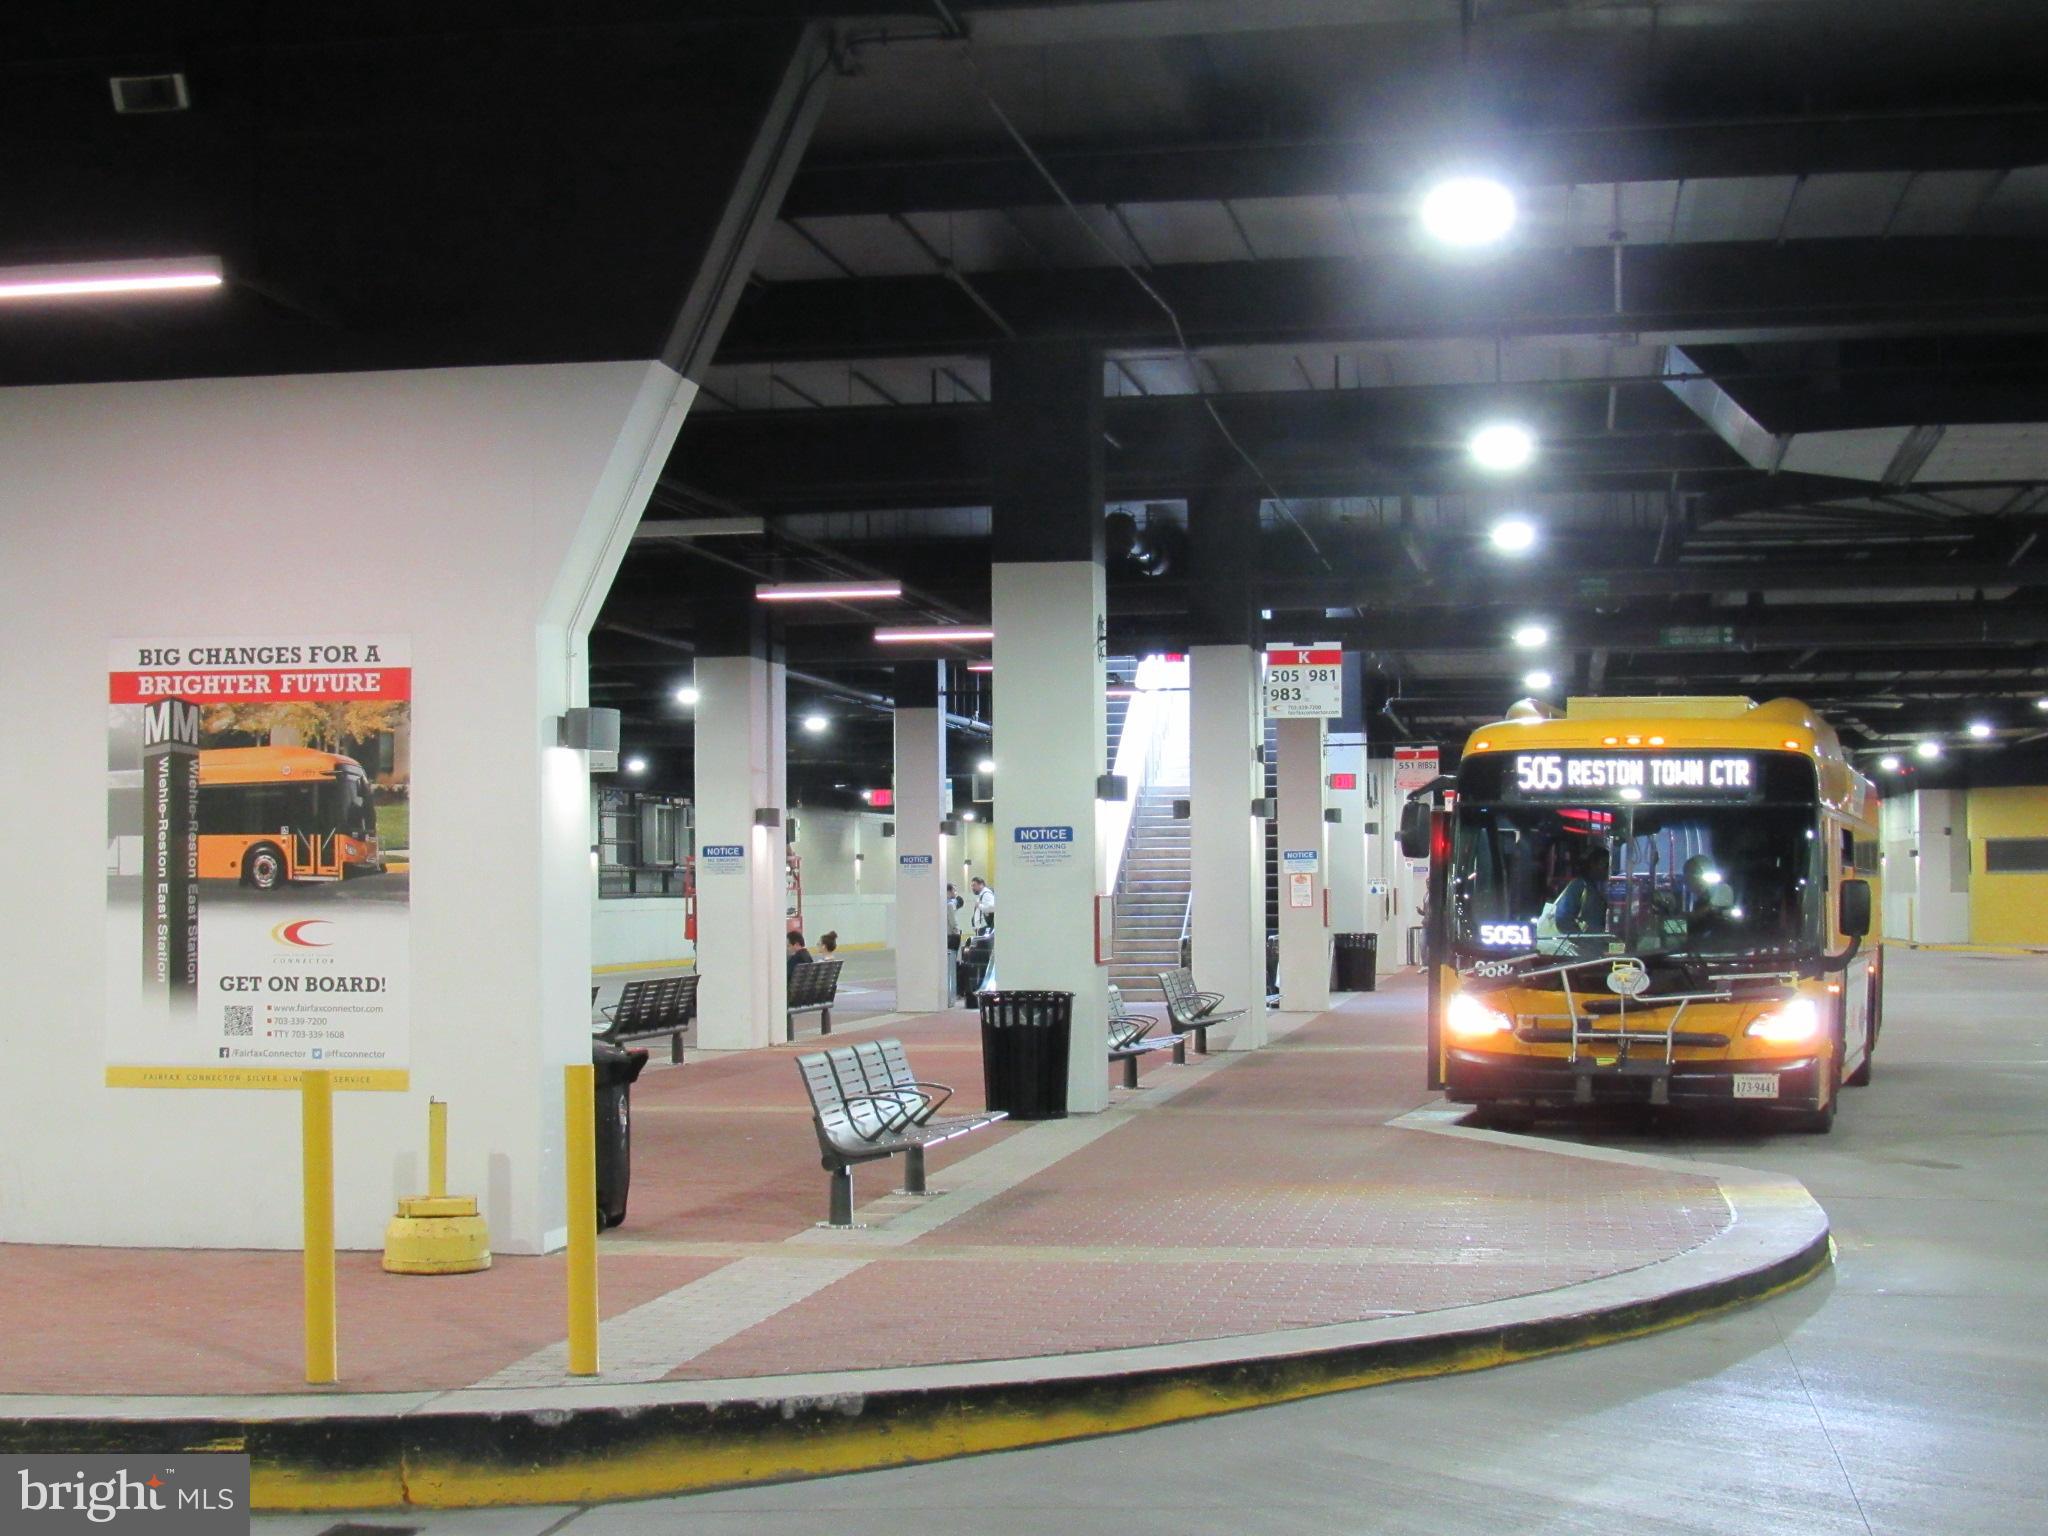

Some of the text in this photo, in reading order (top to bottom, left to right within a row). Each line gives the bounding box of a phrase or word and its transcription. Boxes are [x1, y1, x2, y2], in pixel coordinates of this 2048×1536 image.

[139, 645, 381, 666] BIG CHANGES FOR A
[1298, 651, 1310, 664] K
[138, 672, 381, 696] BRIGHTER FUTURE
[1271, 669, 1336, 682] 505 981
[1271, 688, 1301, 701] 983
[1517, 756, 1750, 789] 505 RESTON TOWN CTR
[1021, 829, 1067, 840] NOTICE
[707, 847, 739, 856] NOTICE
[157, 756, 169, 982] Wiehle-Reston East Station
[188, 884, 199, 920] East
[1480, 925, 1532, 946] 5051
[187, 924, 198, 984] Station
[219, 976, 386, 993] GET ON BOARD!
[274, 1003, 384, 1013] www.fairfaxconnector.com
[274, 1017, 327, 1026] 703-339-7200
